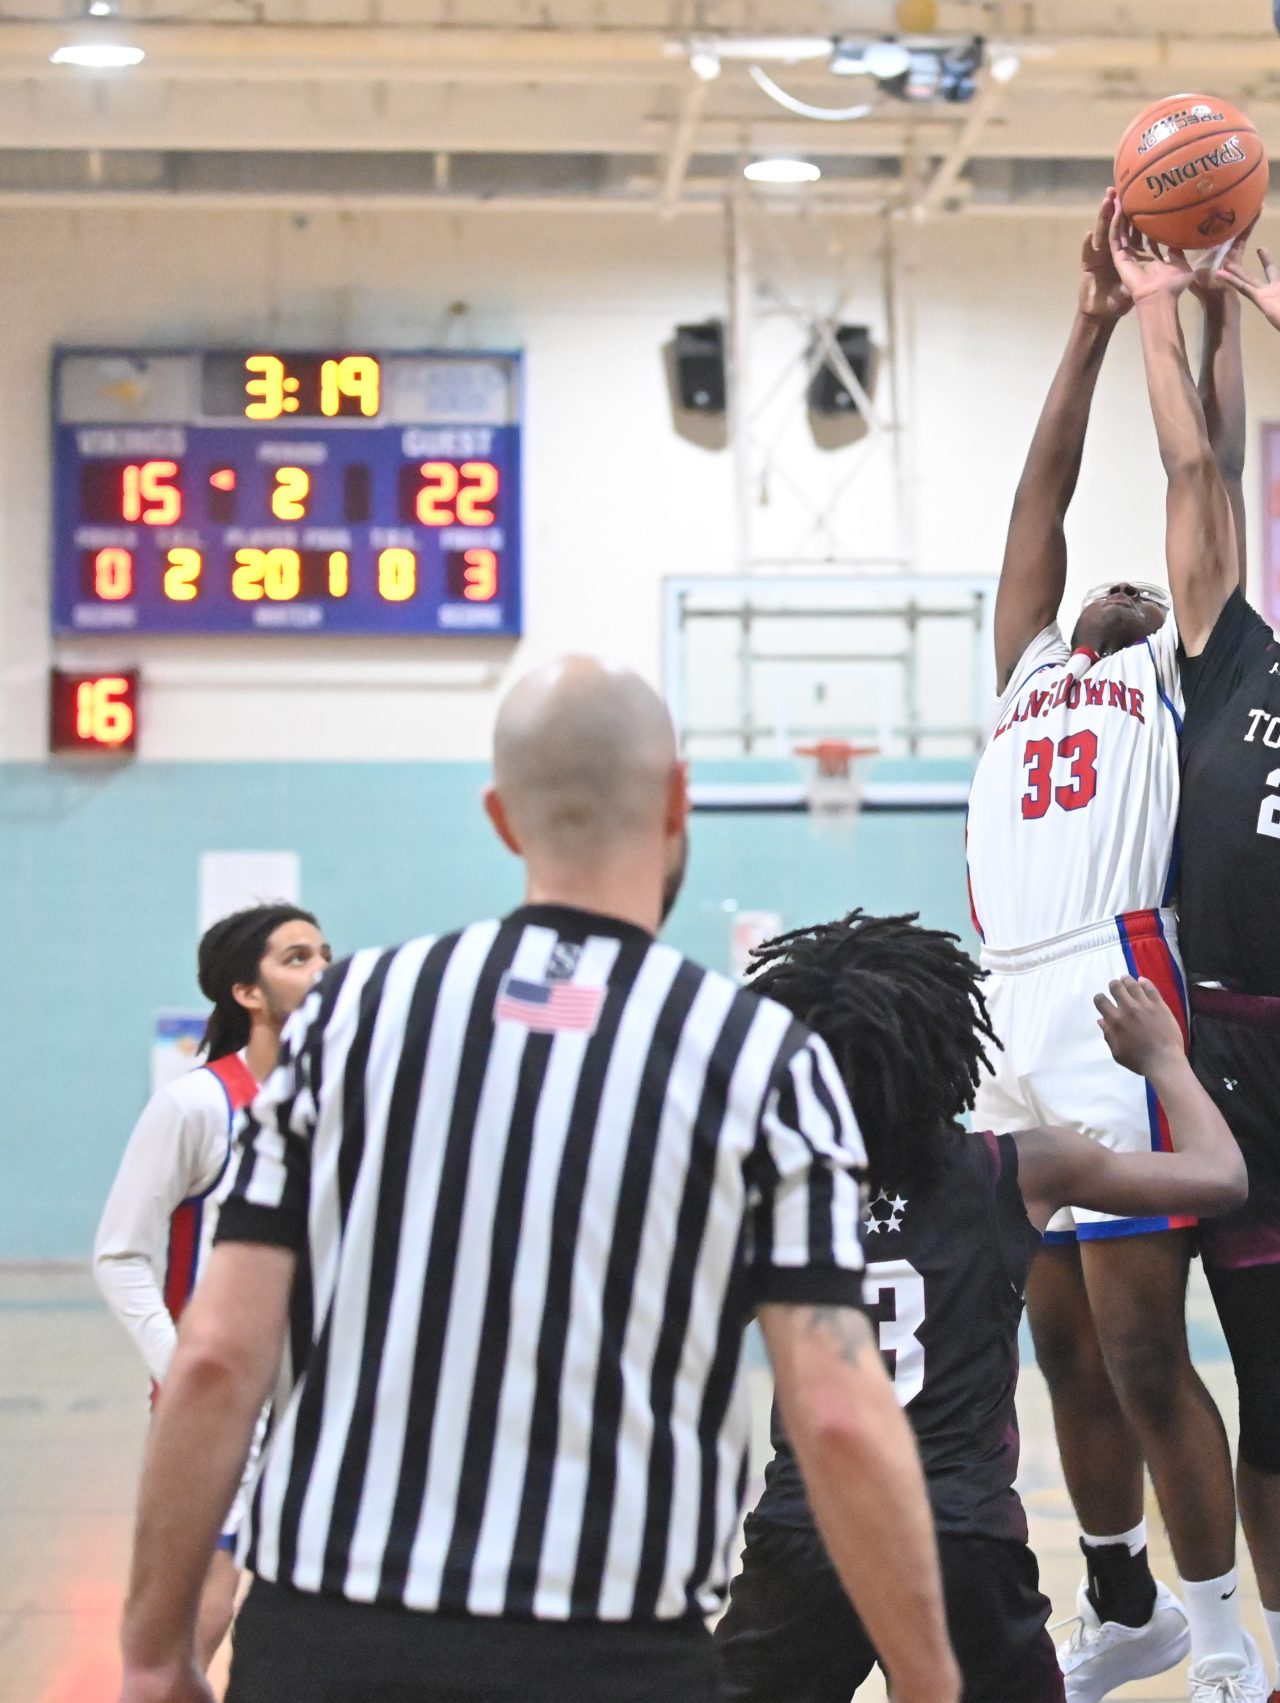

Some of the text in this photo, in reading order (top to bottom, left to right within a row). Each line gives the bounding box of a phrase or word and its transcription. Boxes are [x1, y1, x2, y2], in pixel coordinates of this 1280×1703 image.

[1146, 134, 1246, 200] SPALDING
[122, 461, 182, 526] 15
[271, 466, 310, 521] 2
[415, 461, 499, 526] 22
[95, 547, 132, 600] 0
[163, 547, 201, 601] 2
[378, 547, 417, 601] 0
[463, 548, 498, 601] 3
[76, 676, 134, 744] 16
[1021, 729, 1098, 819] 33
